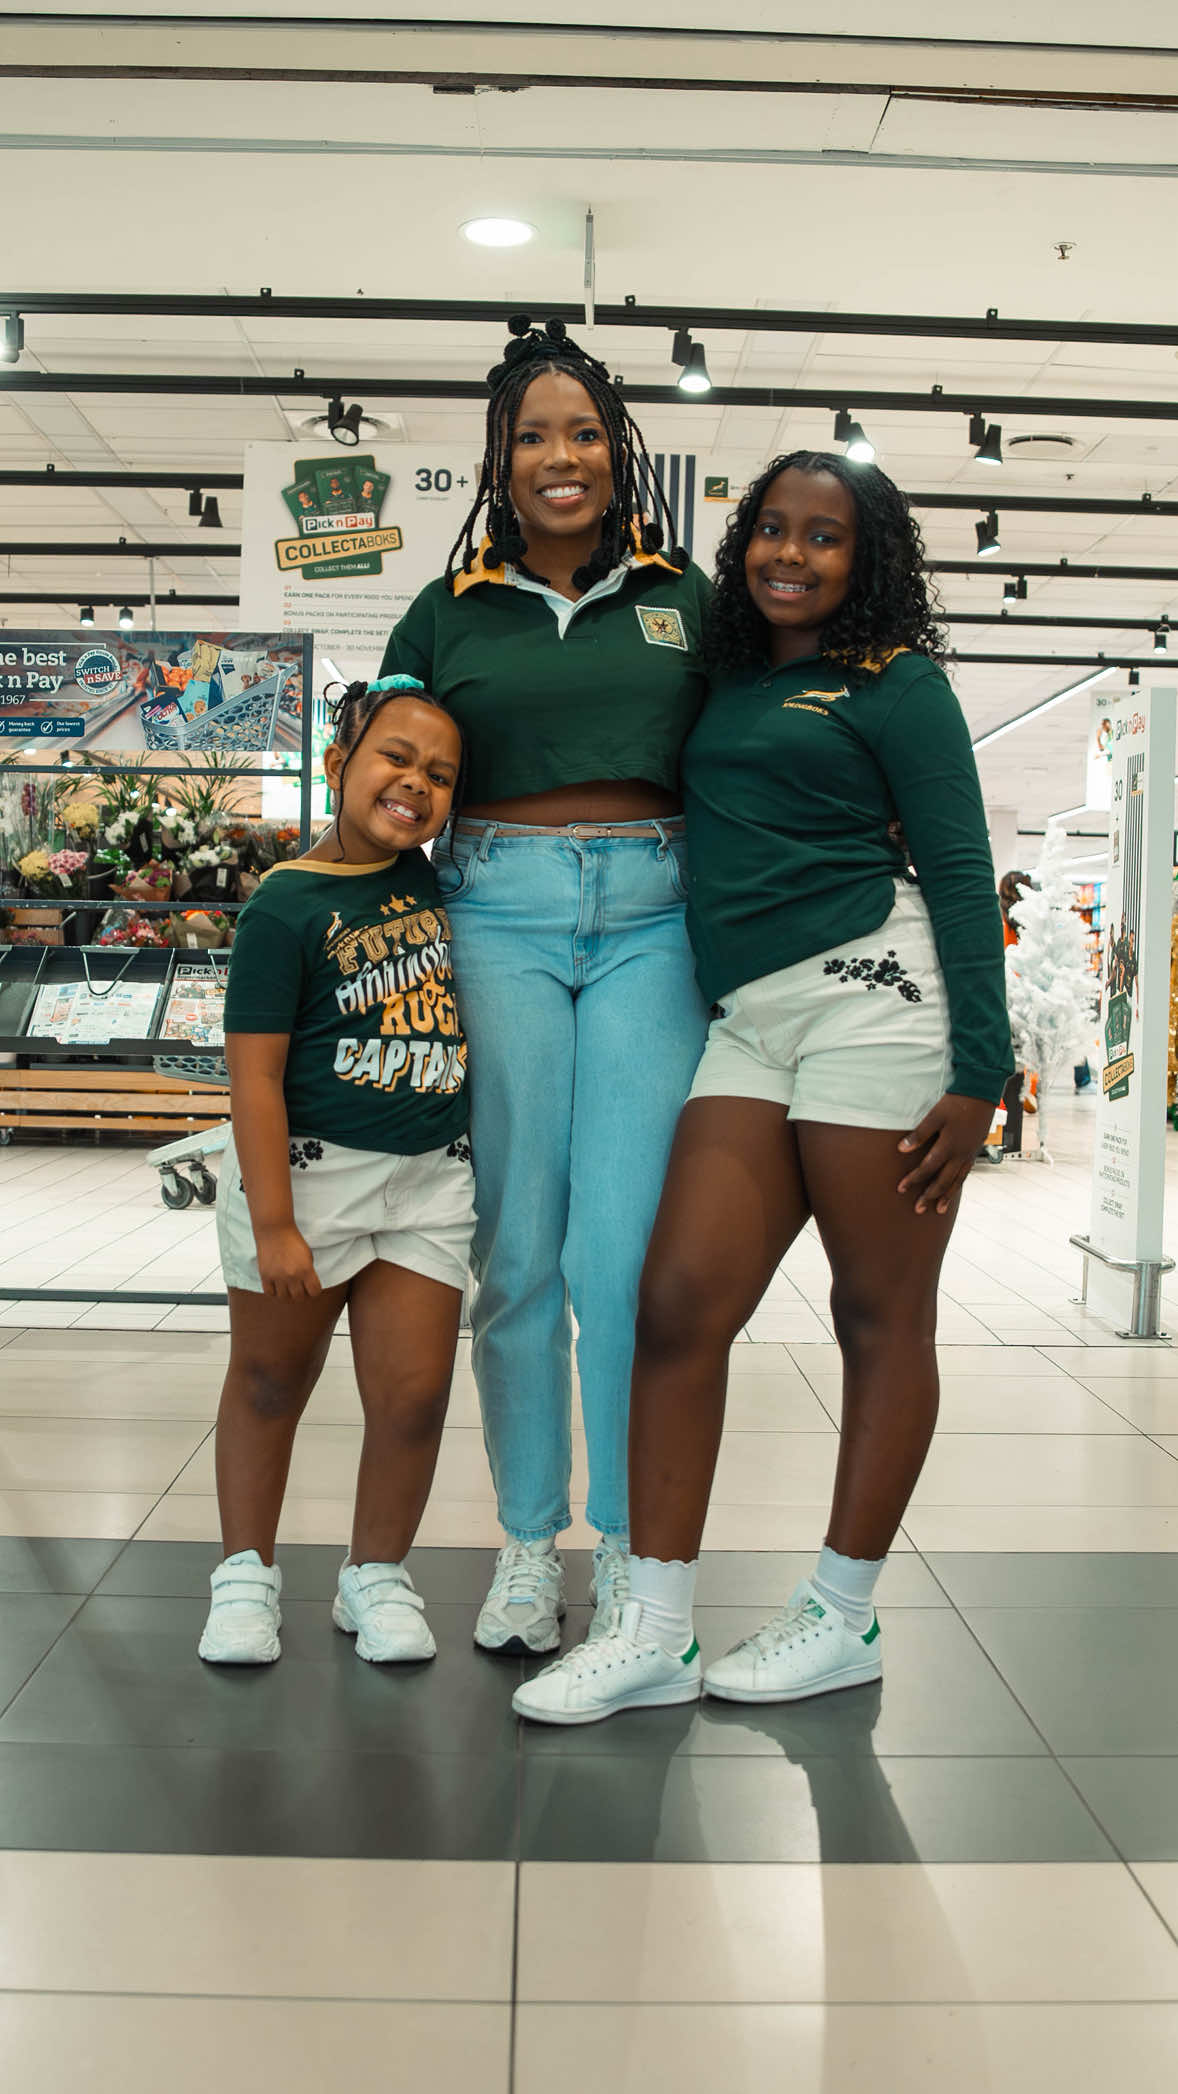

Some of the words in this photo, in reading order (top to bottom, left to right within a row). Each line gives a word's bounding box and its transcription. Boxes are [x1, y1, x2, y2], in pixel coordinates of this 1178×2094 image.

[305, 518, 334, 531] Pick
[335, 518, 344, 528] n
[345, 515, 374, 528] Pay
[284, 532, 398, 561] COLLECTABOKS
[314, 565, 340, 573] COLLECT
[22, 648, 67, 666] best
[76, 665, 110, 677] SWITCH
[87, 676, 94, 684] n
[95, 671, 122, 682] SAVE
[8, 675, 22, 689] n
[26, 672, 63, 694] Pay
[0, 694, 26, 705] 1967
[178, 966, 211, 975] Pick
